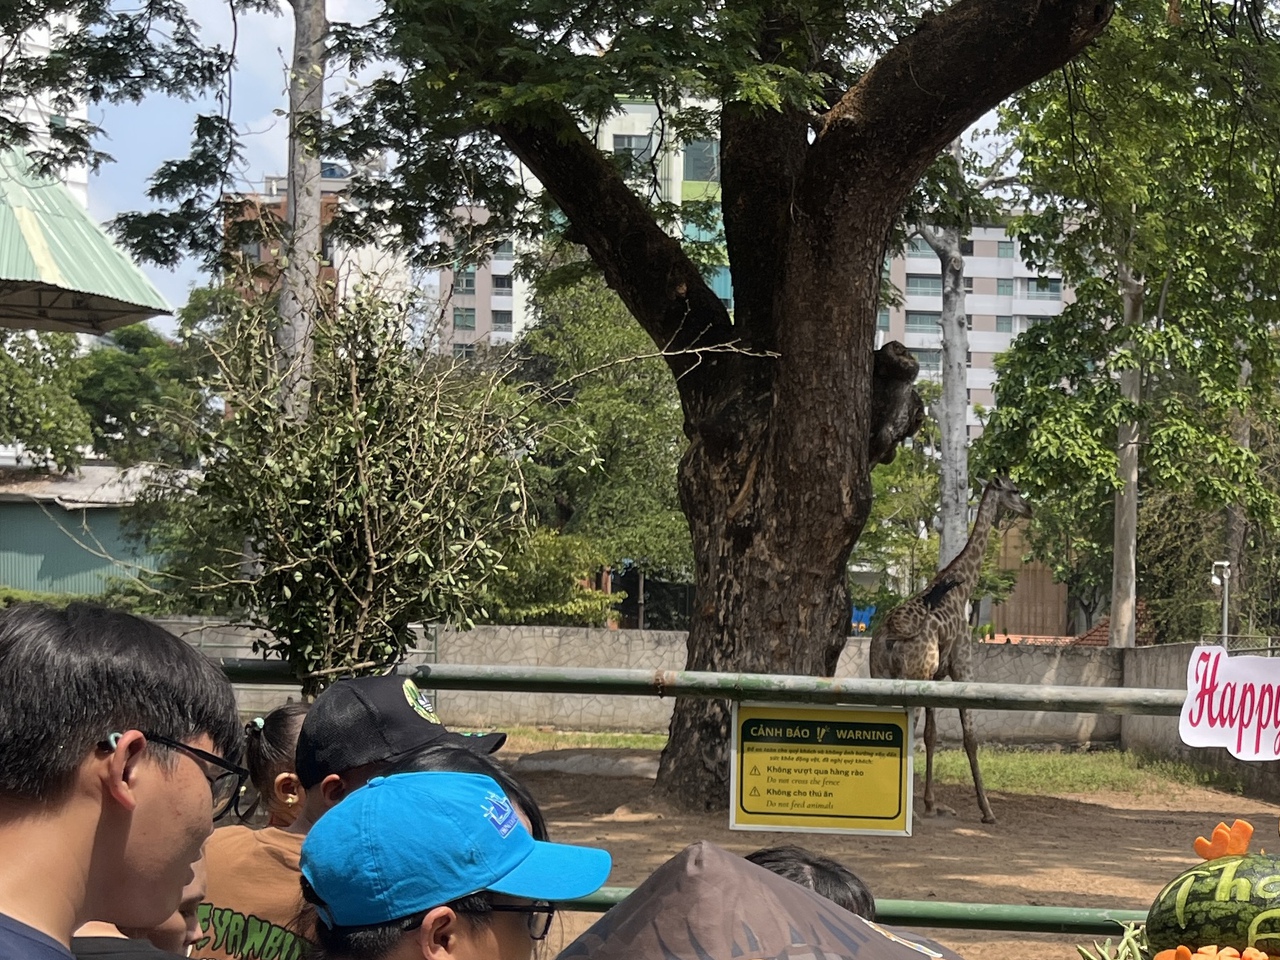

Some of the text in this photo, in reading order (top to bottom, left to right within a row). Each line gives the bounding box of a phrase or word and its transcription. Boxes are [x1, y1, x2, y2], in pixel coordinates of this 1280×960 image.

[751, 724, 810, 739] CẢNH BÁO
[836, 729, 893, 741] WARNING
[767, 766, 792, 775] Không
[794, 767, 812, 775] vượt
[830, 768, 850, 777] hàng
[821, 777, 840, 787] fence
[766, 788, 792, 797] Không
[766, 800, 777, 808] Do
[790, 800, 805, 810] feed
